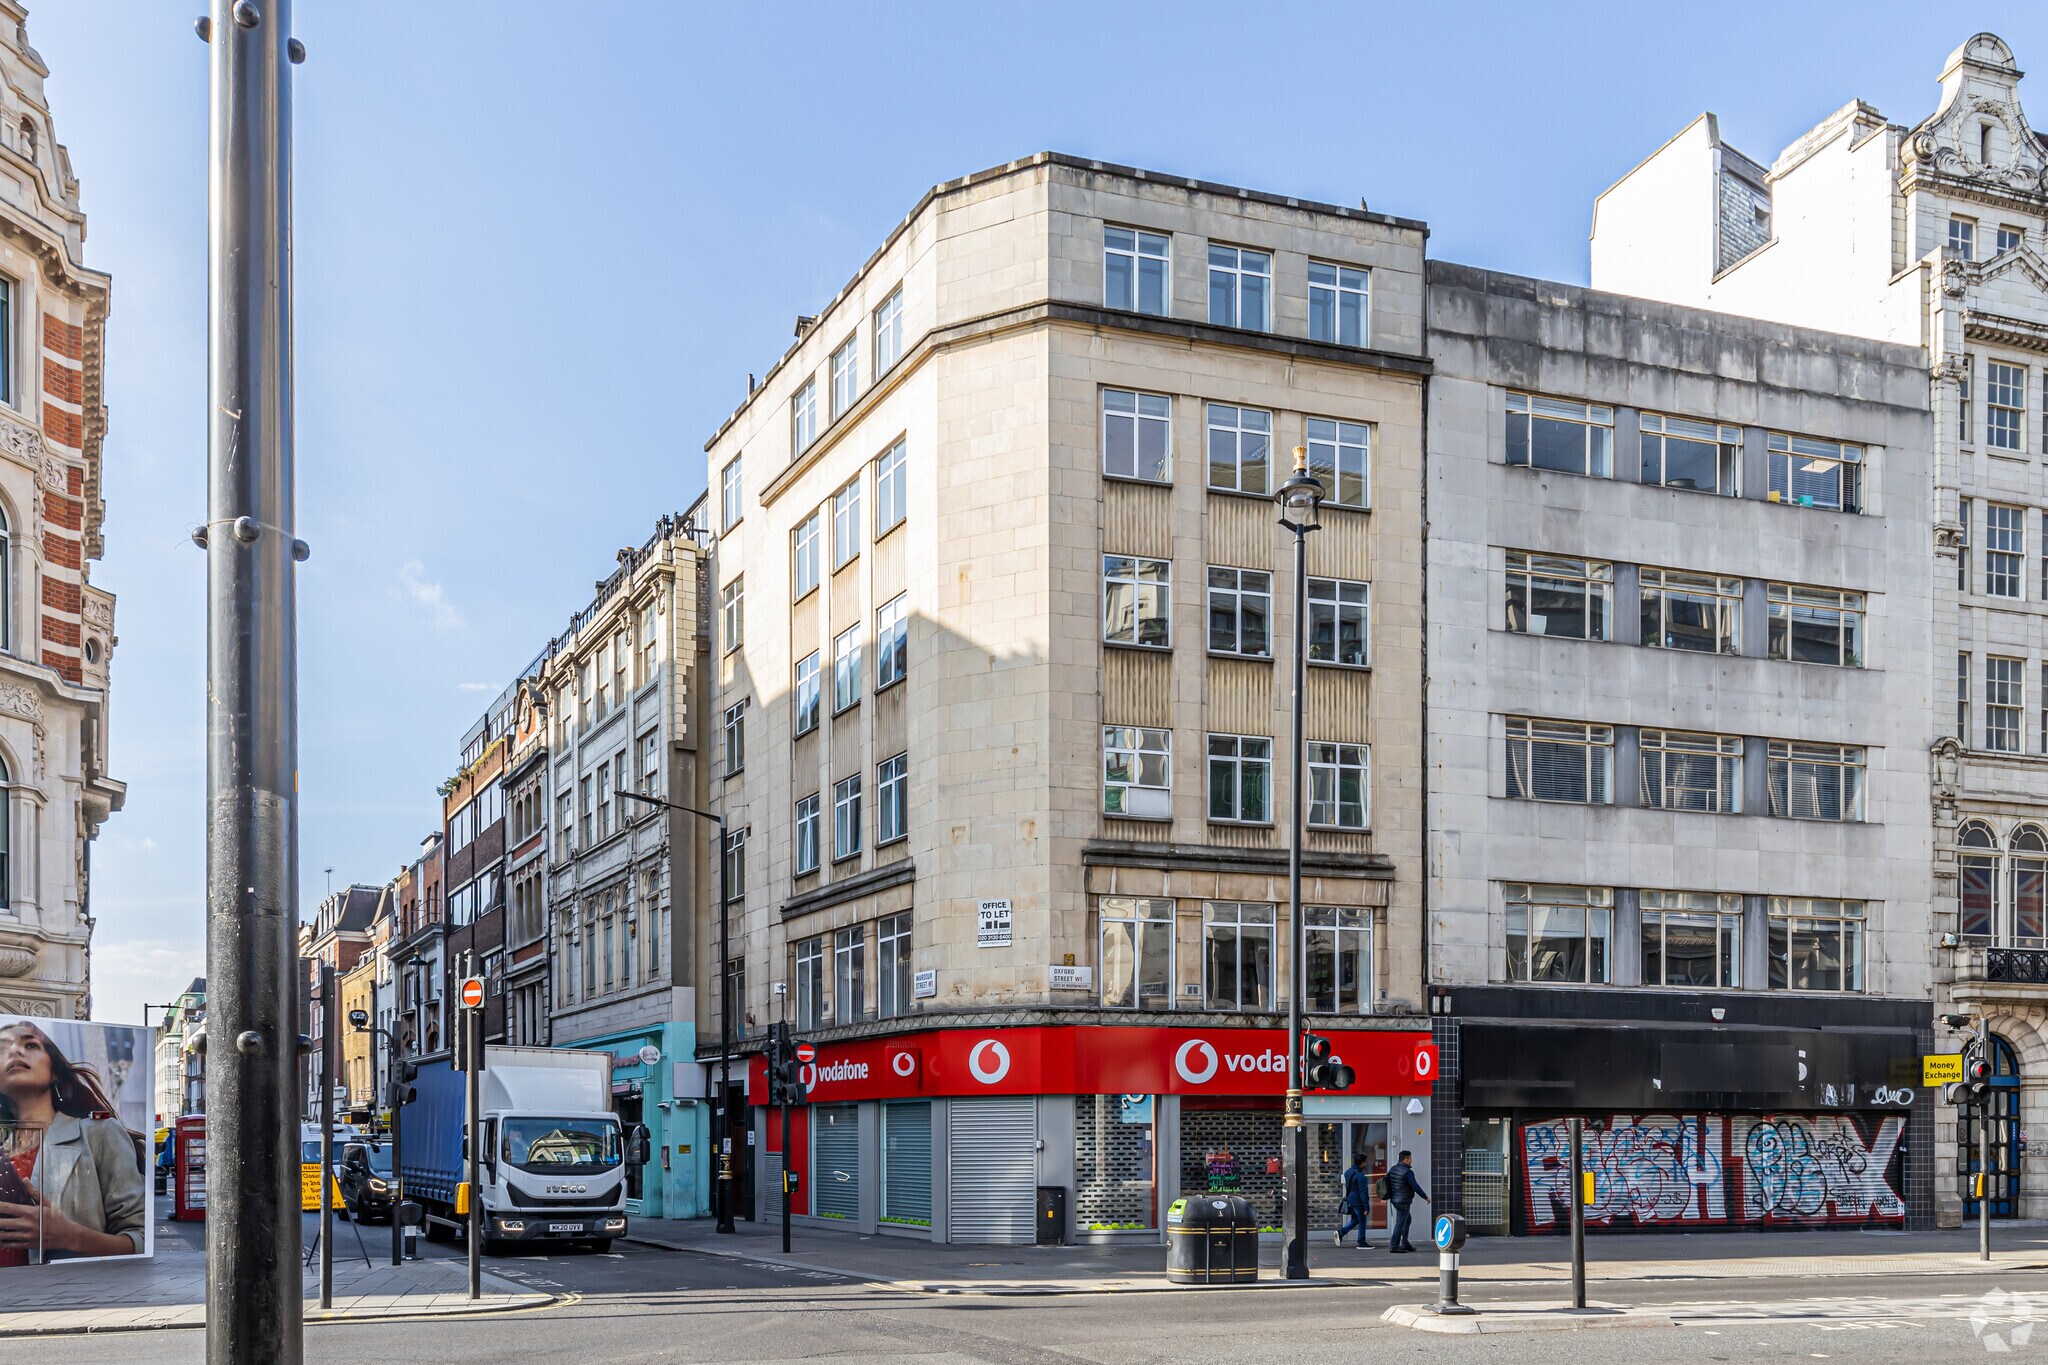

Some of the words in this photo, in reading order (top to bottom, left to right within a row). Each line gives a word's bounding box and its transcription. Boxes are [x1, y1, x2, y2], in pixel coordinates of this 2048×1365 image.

[982, 901, 1007, 909] OFFICE
[980, 911, 992, 919] TO
[994, 910, 1010, 918] LET
[915, 981, 928, 990] STREET
[818, 1059, 869, 1082] vodafone
[1929, 1062, 1956, 1070] Money
[1925, 1071, 1961, 1079] Exchange
[546, 1184, 587, 1194] IVECO
